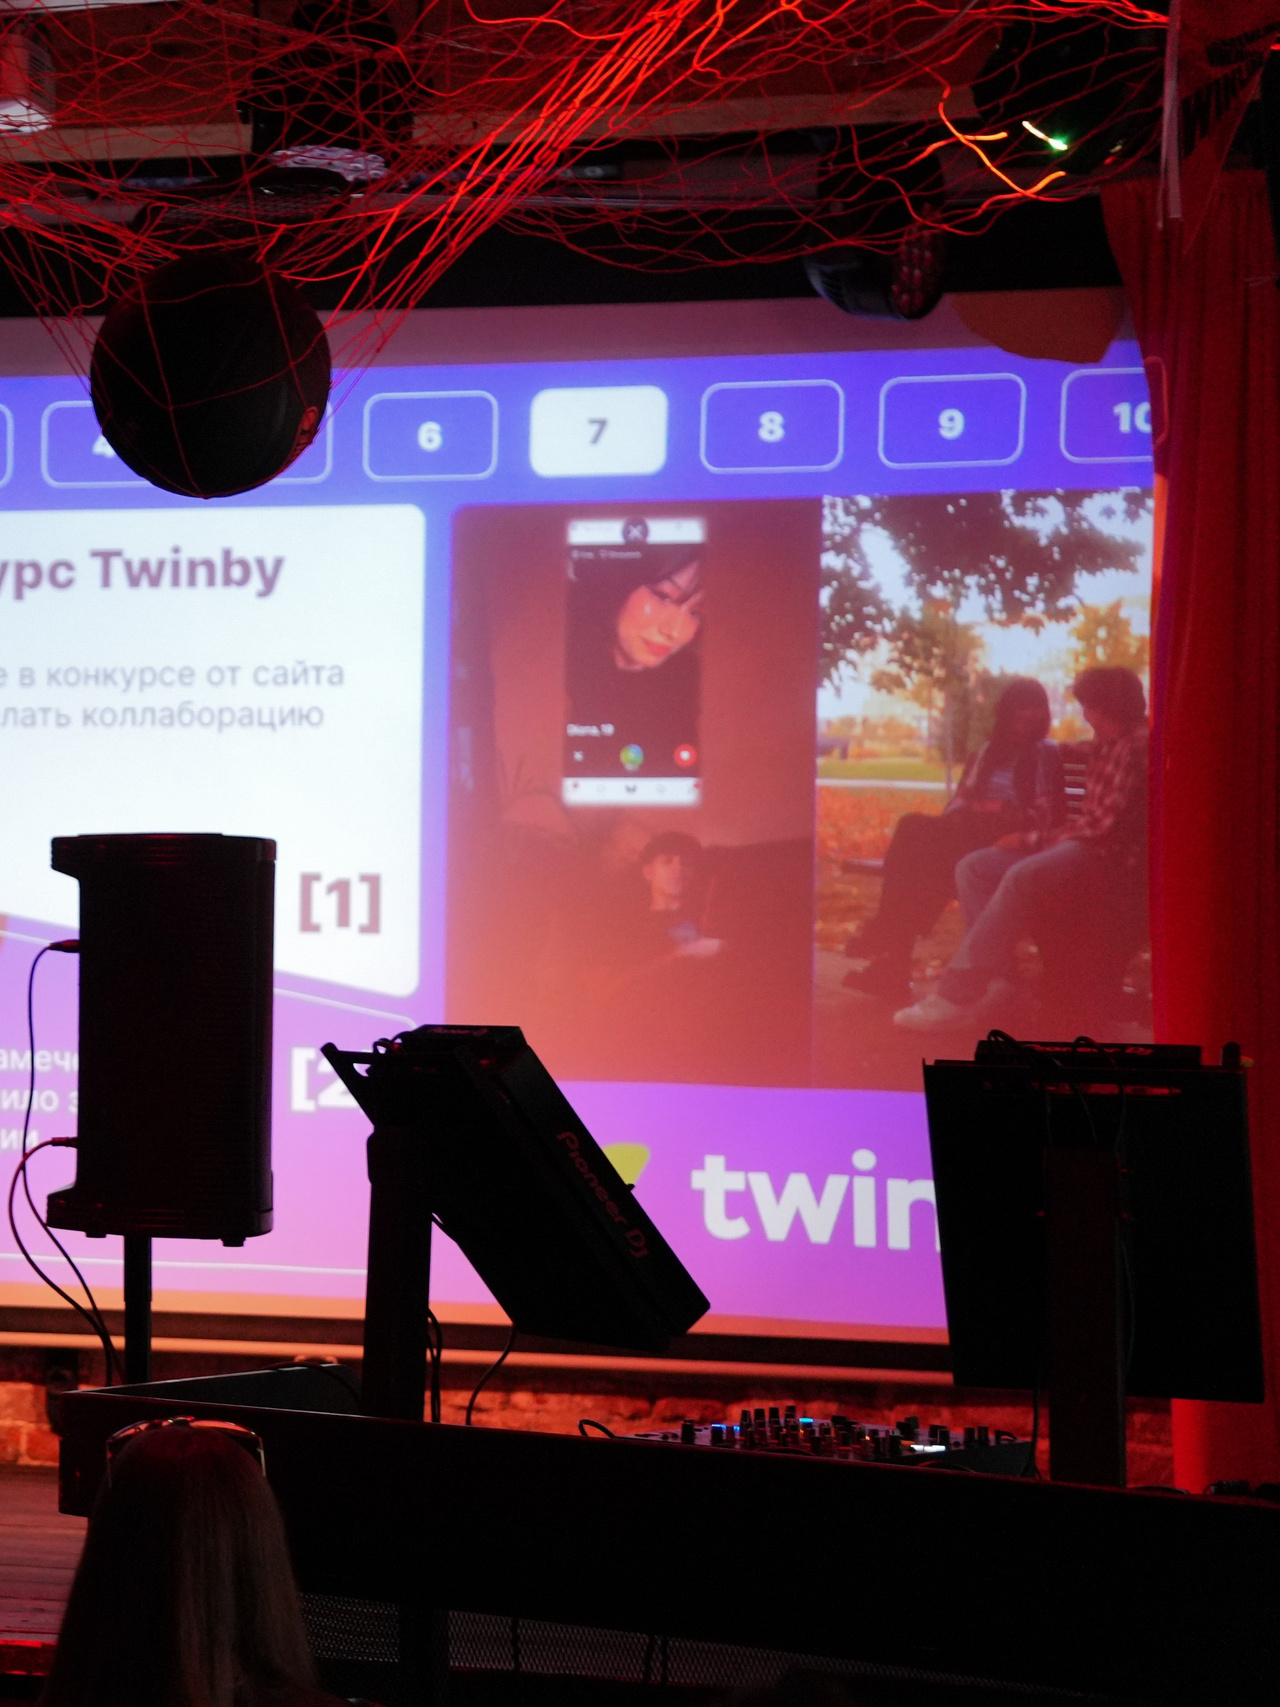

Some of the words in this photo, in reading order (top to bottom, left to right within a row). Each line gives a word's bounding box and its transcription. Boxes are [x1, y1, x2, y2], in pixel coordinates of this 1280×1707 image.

[418, 421, 443, 452] 6
[588, 418, 609, 446] 7
[758, 411, 785, 443] 8
[938, 408, 965, 440] 9
[90, 545, 286, 598] Twinby
[18, 666, 36, 688] в
[46, 664, 196, 694] конкурсе
[206, 664, 241, 687] от
[252, 660, 345, 687] сайта
[81, 700, 325, 734] коллаборацию
[299, 872, 381, 934] [1]
[556, 1130, 628, 1224] Pioneer
[626, 1227, 651, 1259] DJ
